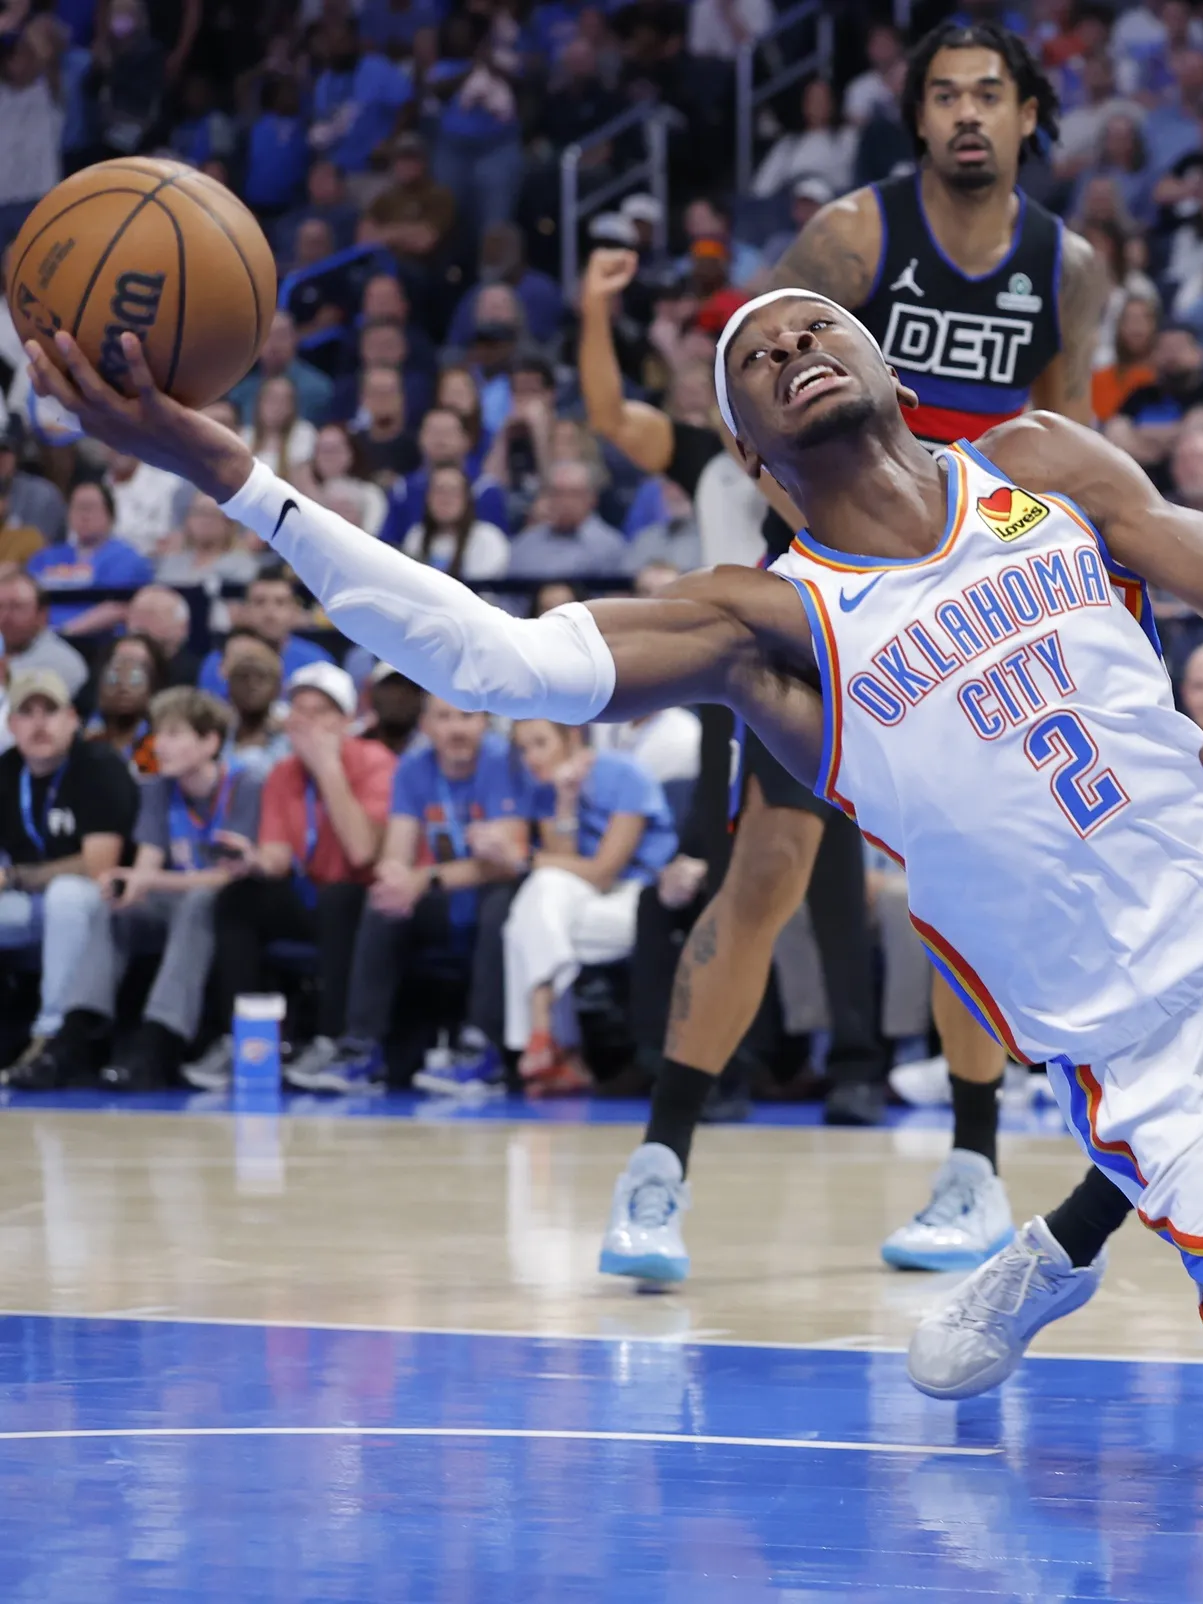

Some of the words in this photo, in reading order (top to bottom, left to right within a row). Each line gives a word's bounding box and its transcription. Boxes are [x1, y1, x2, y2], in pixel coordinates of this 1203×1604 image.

[883, 301, 1033, 383] DET
[847, 545, 1111, 727] OKLAHOMA
[957, 630, 1077, 741] CITY
[1023, 708, 1131, 840] 2
